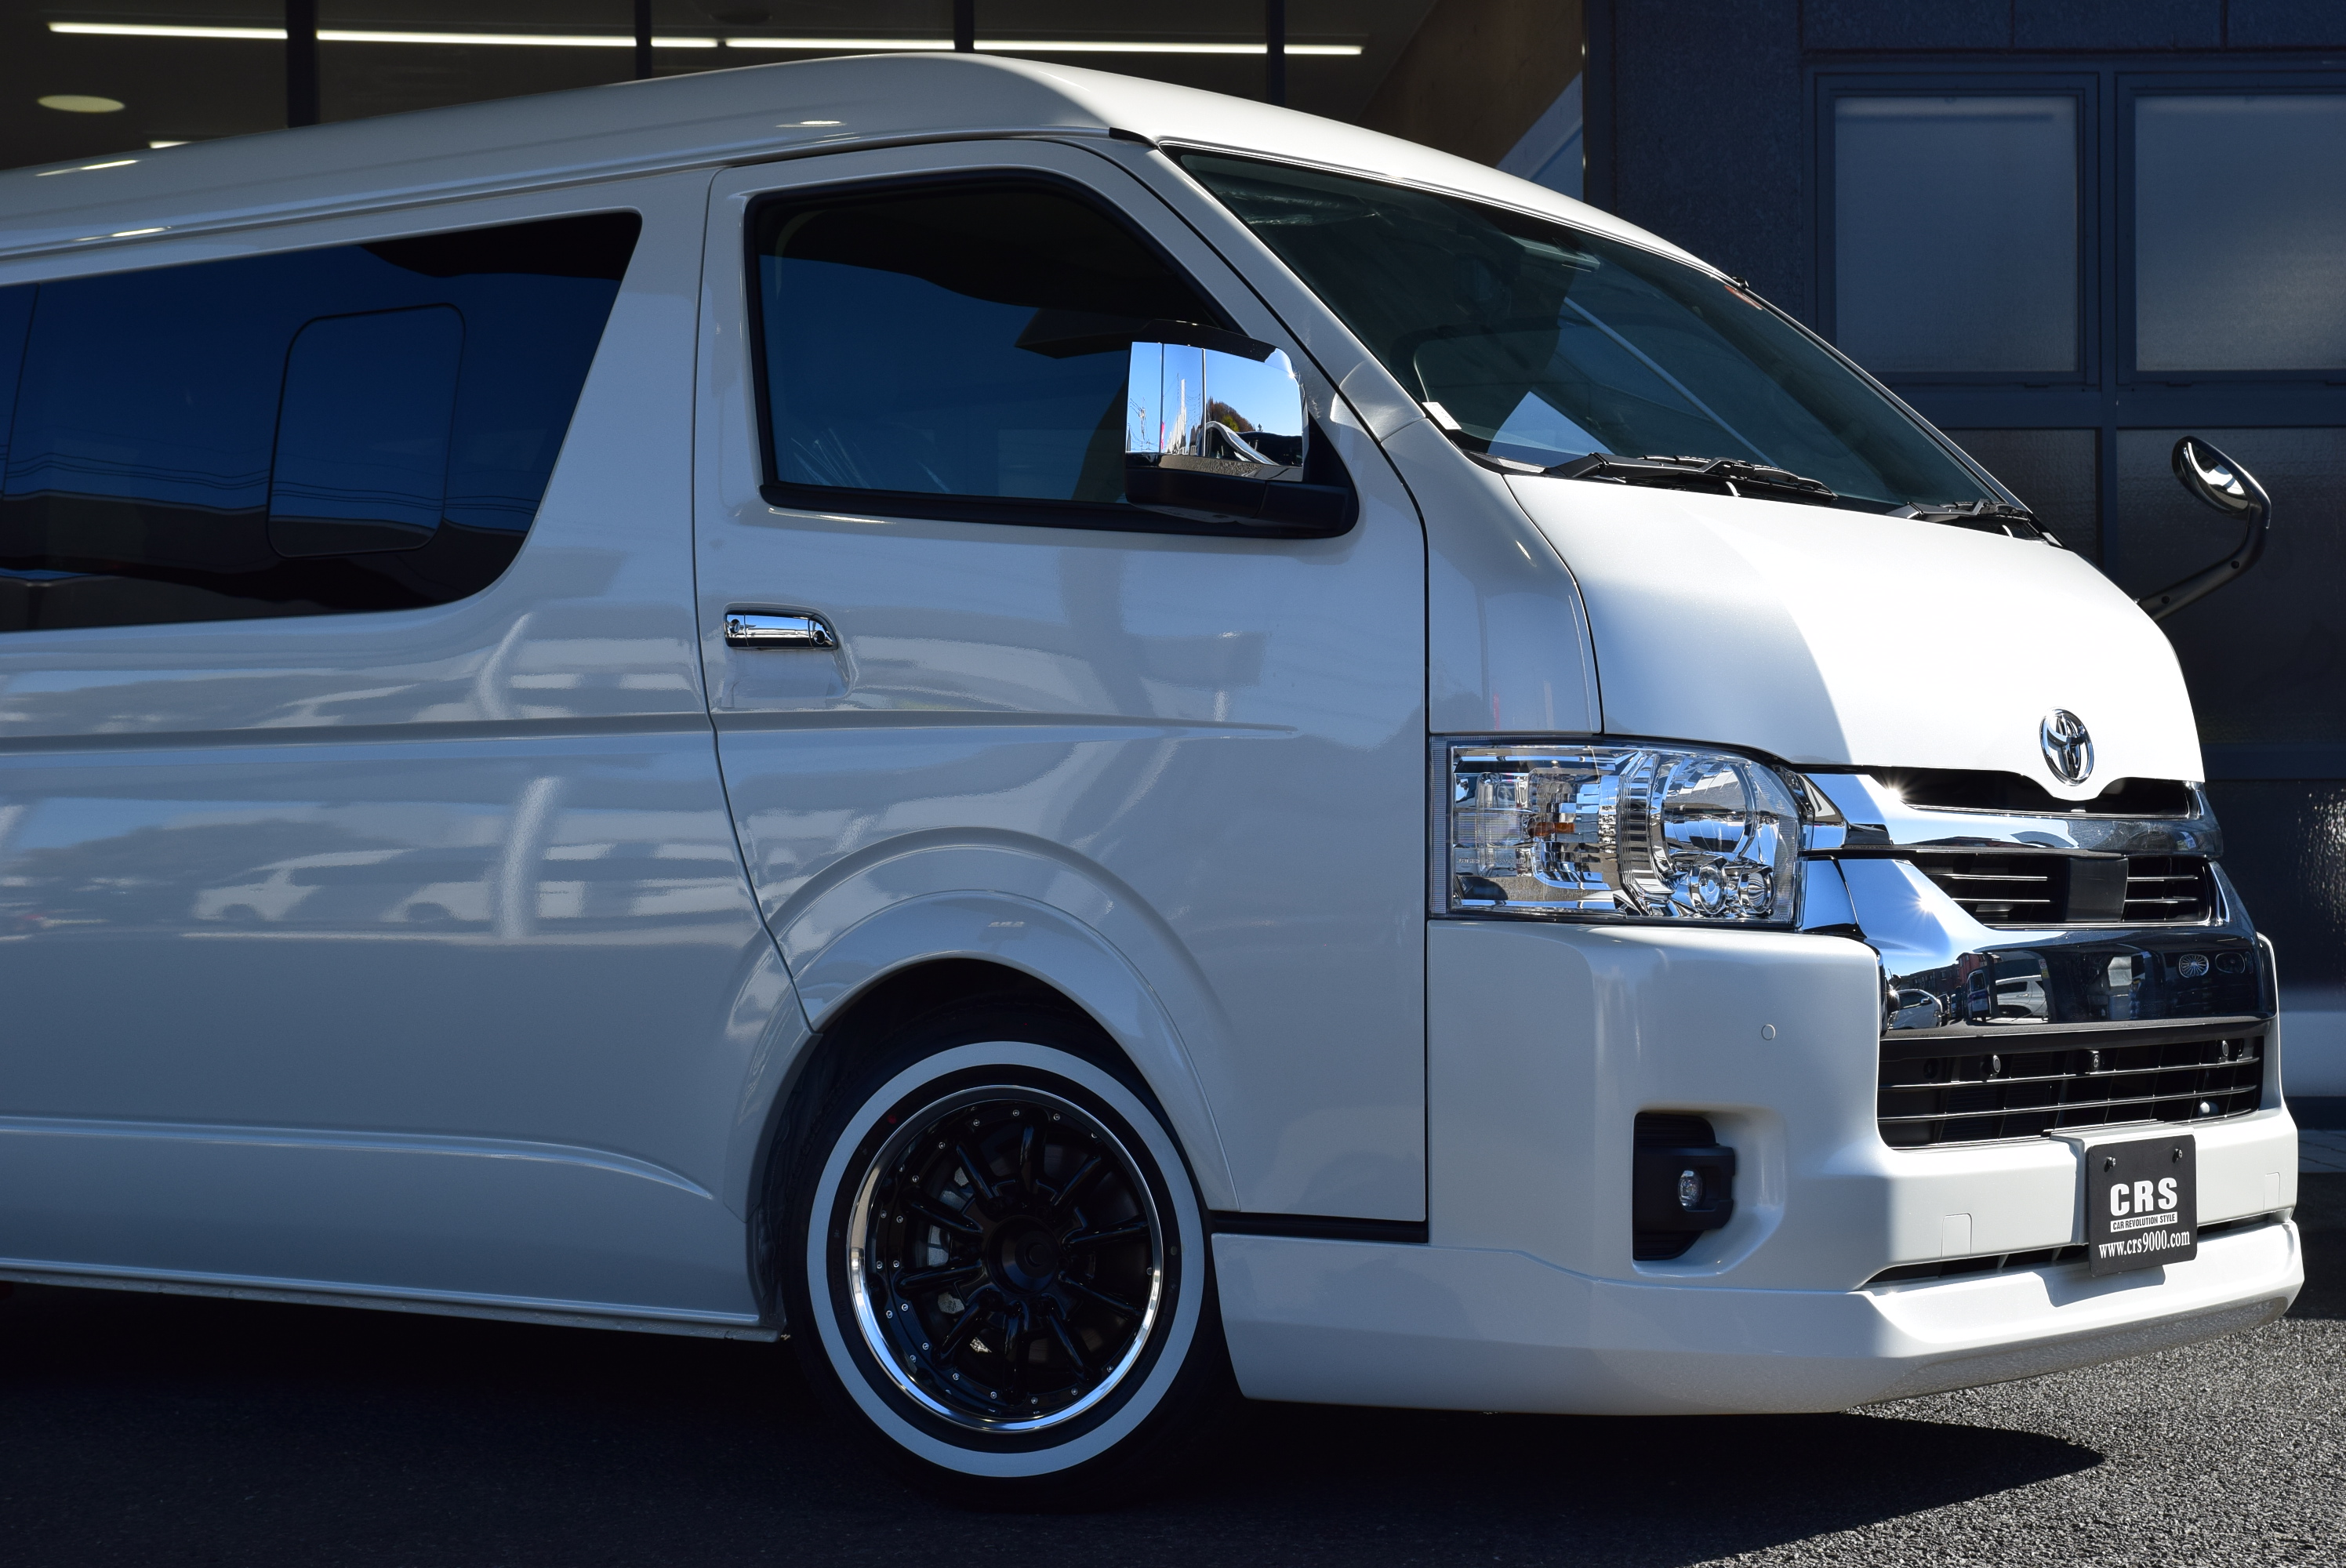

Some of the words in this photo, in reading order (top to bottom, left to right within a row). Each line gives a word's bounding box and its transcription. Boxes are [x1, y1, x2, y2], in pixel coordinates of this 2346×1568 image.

[2110, 1177, 2177, 1217] CRS
[2112, 1220, 2124, 1230] CAR
[2125, 1216, 2158, 1229] REVOLUTION
[2159, 1214, 2175, 1223] STYLE
[2099, 1229, 2190, 1259] www.crs9000.com
